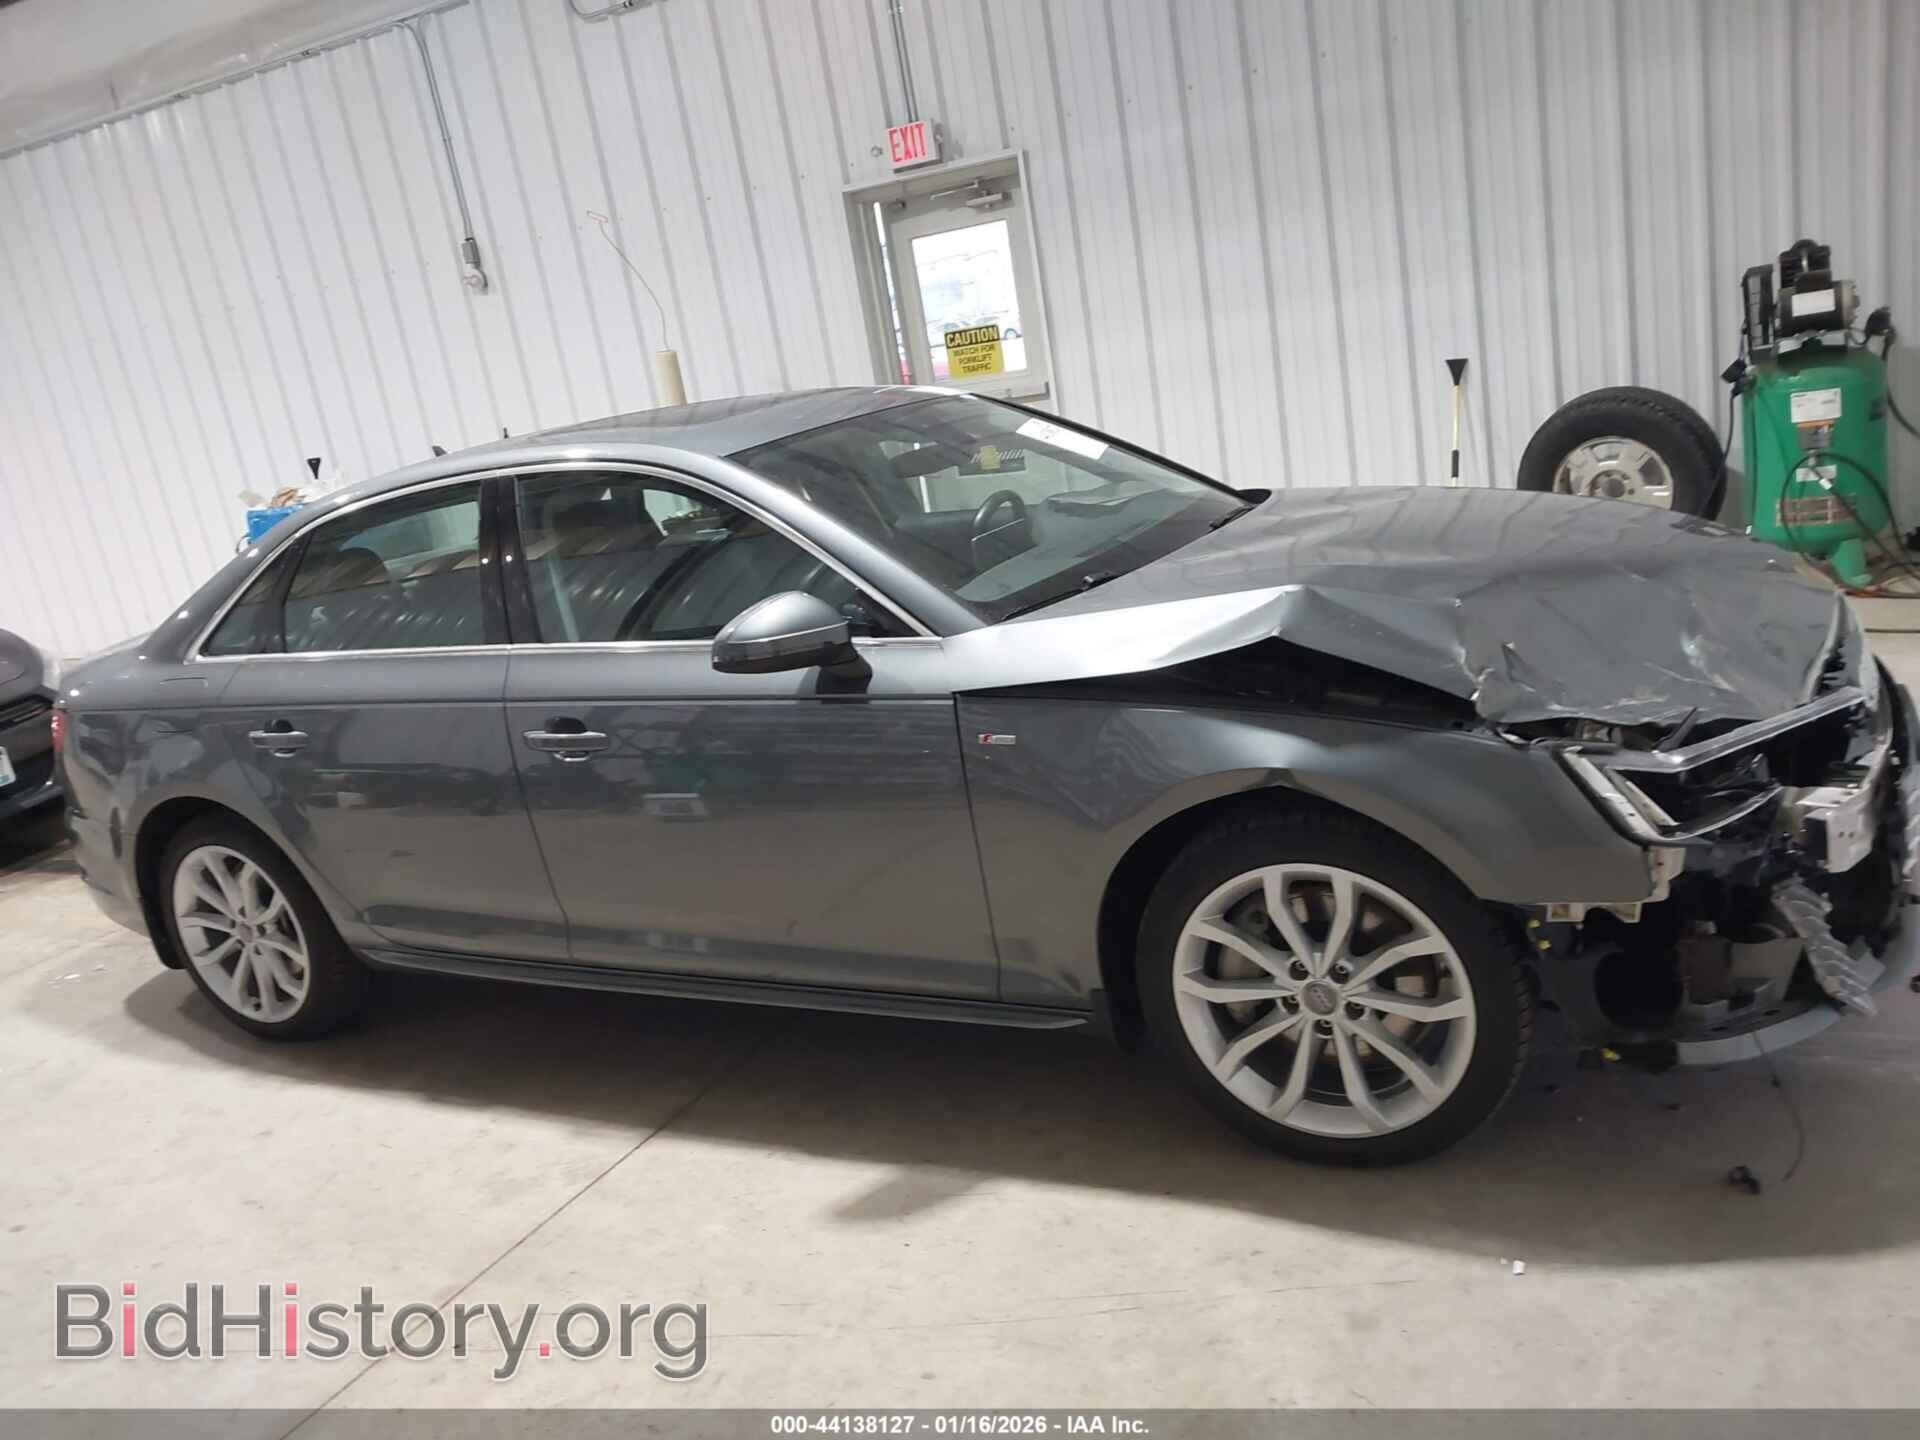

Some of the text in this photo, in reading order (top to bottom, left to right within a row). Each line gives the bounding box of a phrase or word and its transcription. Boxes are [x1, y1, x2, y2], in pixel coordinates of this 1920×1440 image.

[888, 122, 925, 162] EXIT
[945, 327, 998, 347] CAUTION
[980, 343, 996, 353] FOR
[958, 353, 993, 365] FORKLIFT
[961, 362, 993, 374] TRAFFIC
